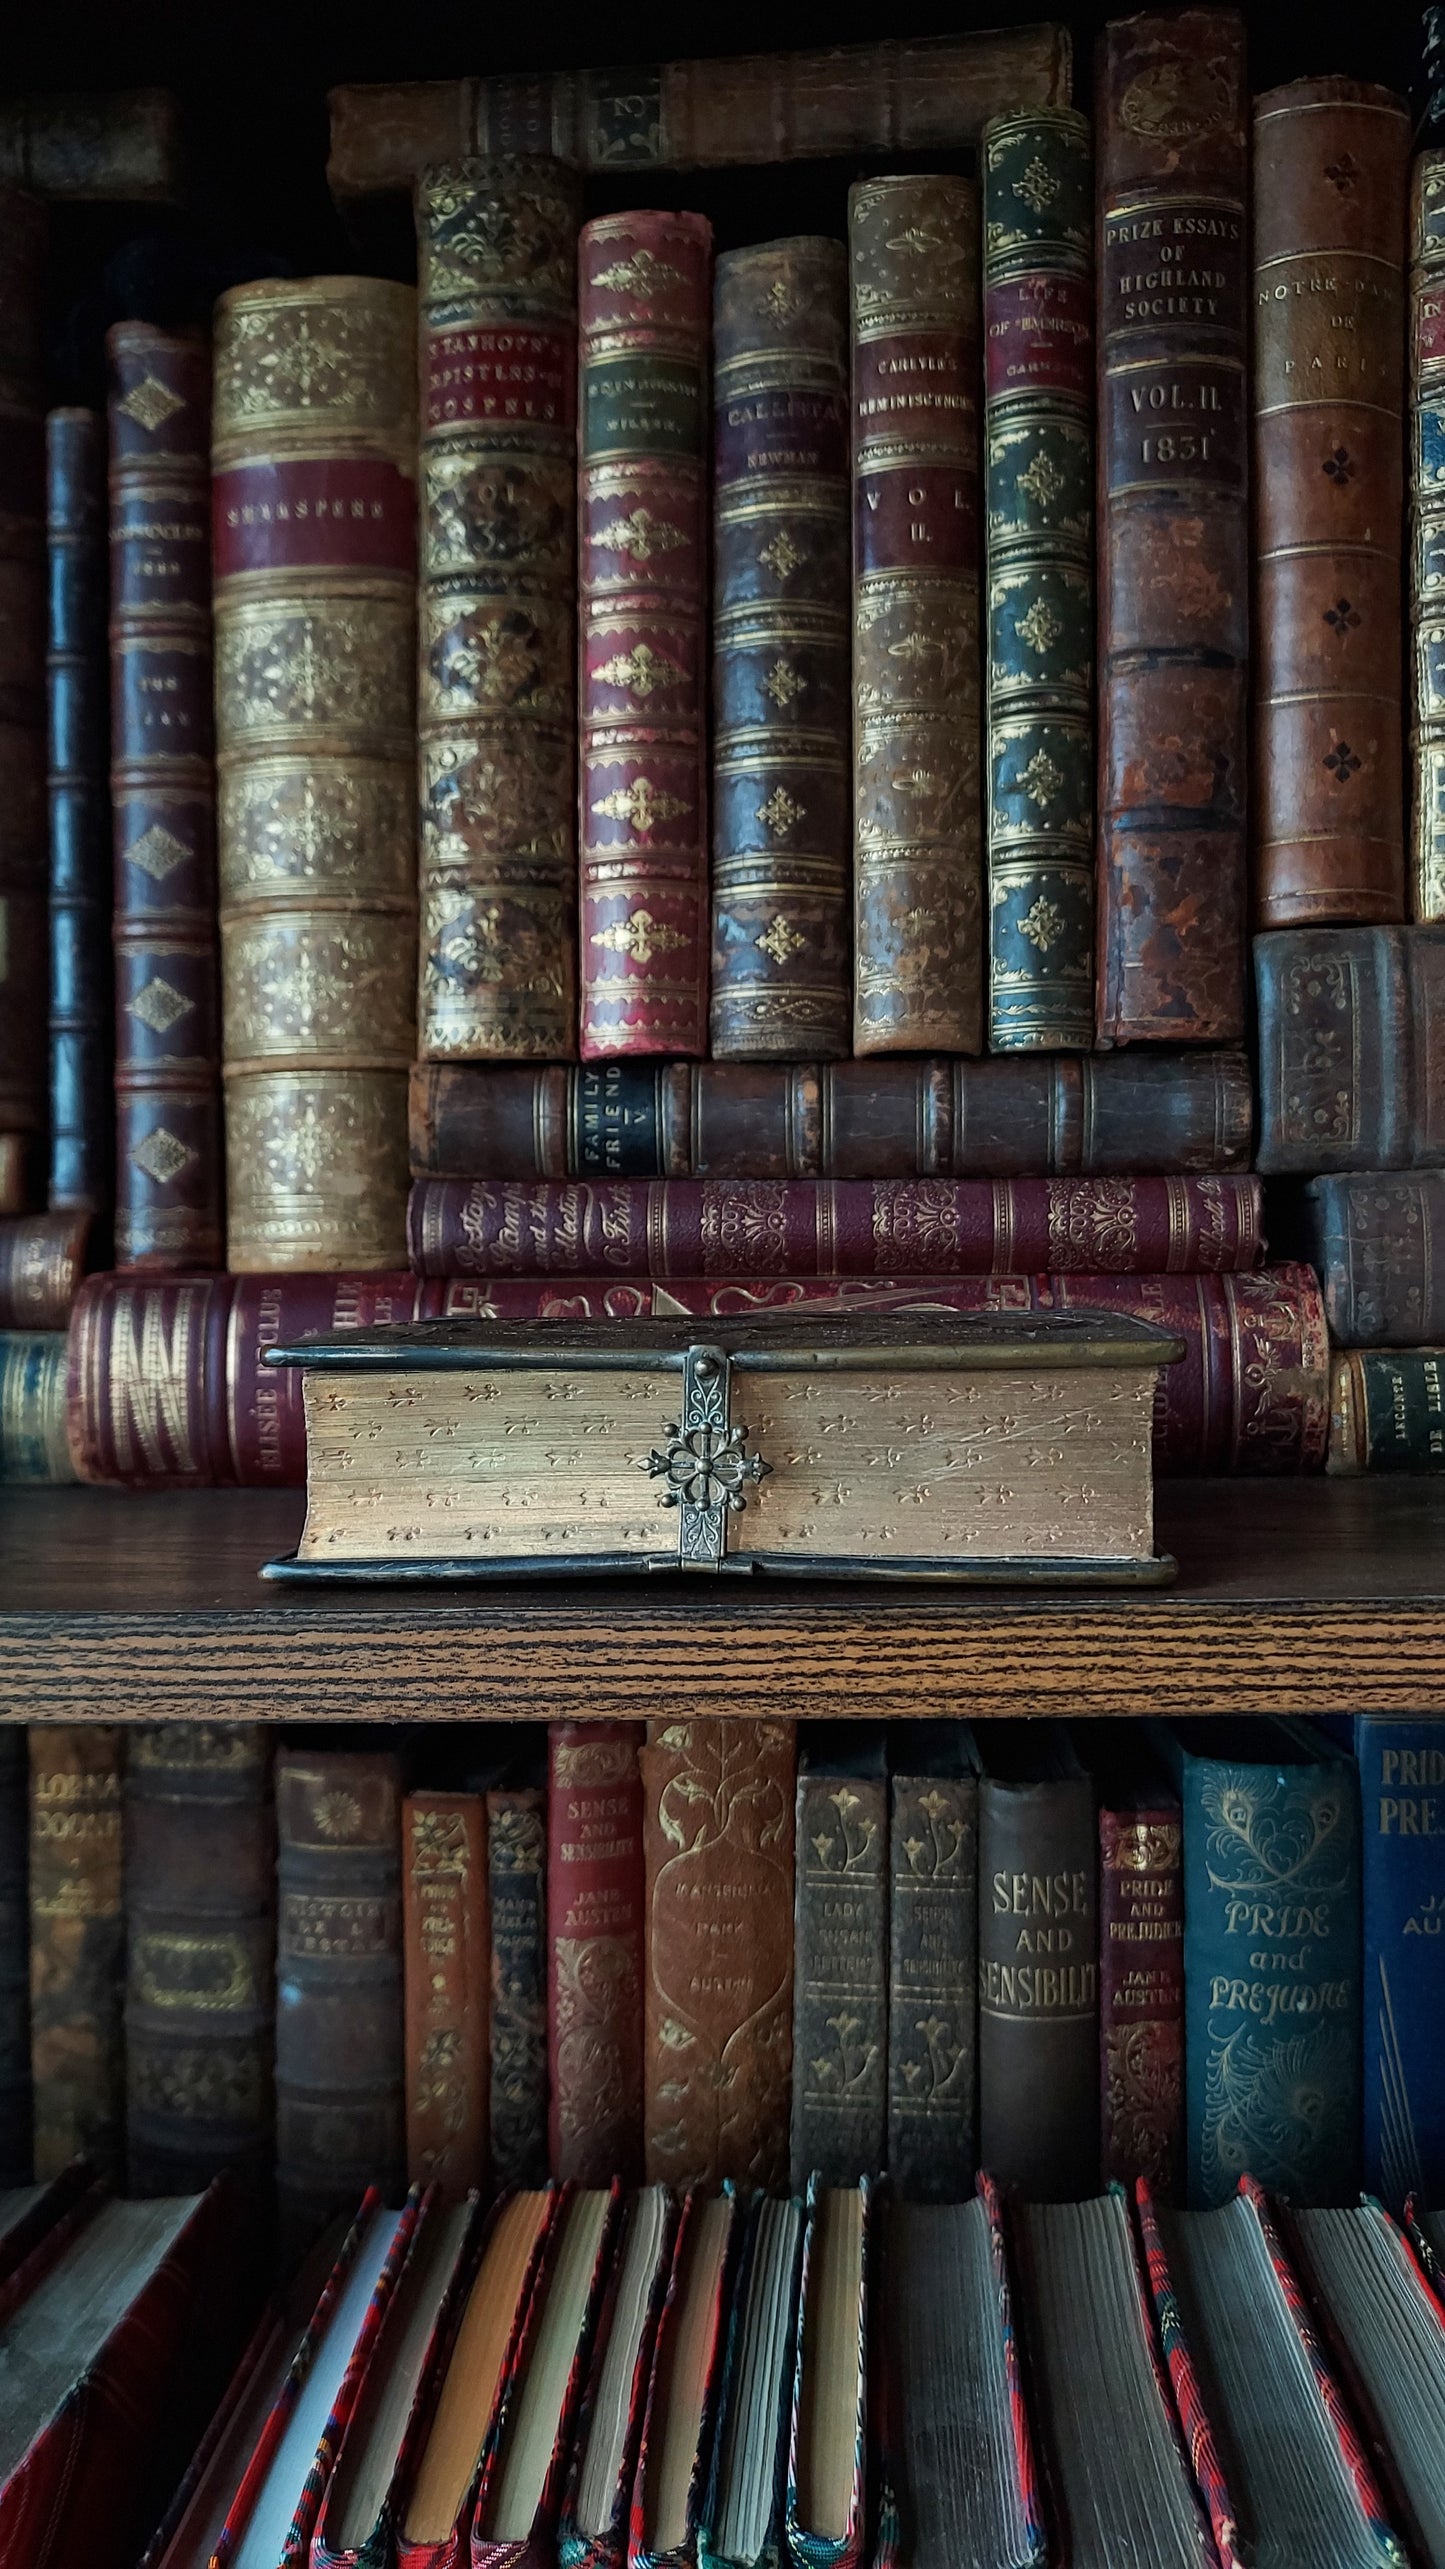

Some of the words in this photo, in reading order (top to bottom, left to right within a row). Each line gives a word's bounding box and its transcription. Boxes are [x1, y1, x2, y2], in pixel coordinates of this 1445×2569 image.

[1107, 219, 1163, 246] PRIZE
[1173, 217, 1240, 240] ESSAYS
[1160, 245, 1186, 263] OF
[1120, 271, 1227, 295] HIGHLAND
[1124, 297, 1218, 319] SOCIETY
[1141, 435, 1210, 464] 1831
[584, 1071, 600, 1161] FAMILY
[605, 1066, 622, 1169] FRIEND
[255, 1287, 283, 1378] RCLUS
[1423, 1360, 1442, 1413] LISLE
[1391, 1376, 1406, 1440] LECONTE
[1429, 1429, 1443, 1454] DE
[567, 1797, 629, 1820] SENSE
[579, 1822, 617, 1839] AND
[573, 1889, 621, 1907] JANE
[992, 1870, 1088, 1918] SENSE
[1119, 1878, 1176, 1898] PRIDE
[564, 1903, 634, 1927] AUSTEN
[823, 1902, 863, 1919] LADY
[1130, 1902, 1166, 1917] AND
[1223, 1900, 1331, 1939] PRIDE
[1015, 1928, 1073, 1953] AND
[1249, 1945, 1312, 1971] and
[1122, 1969, 1172, 1987] JANE
[1208, 1975, 1350, 2026] PREJUDICE
